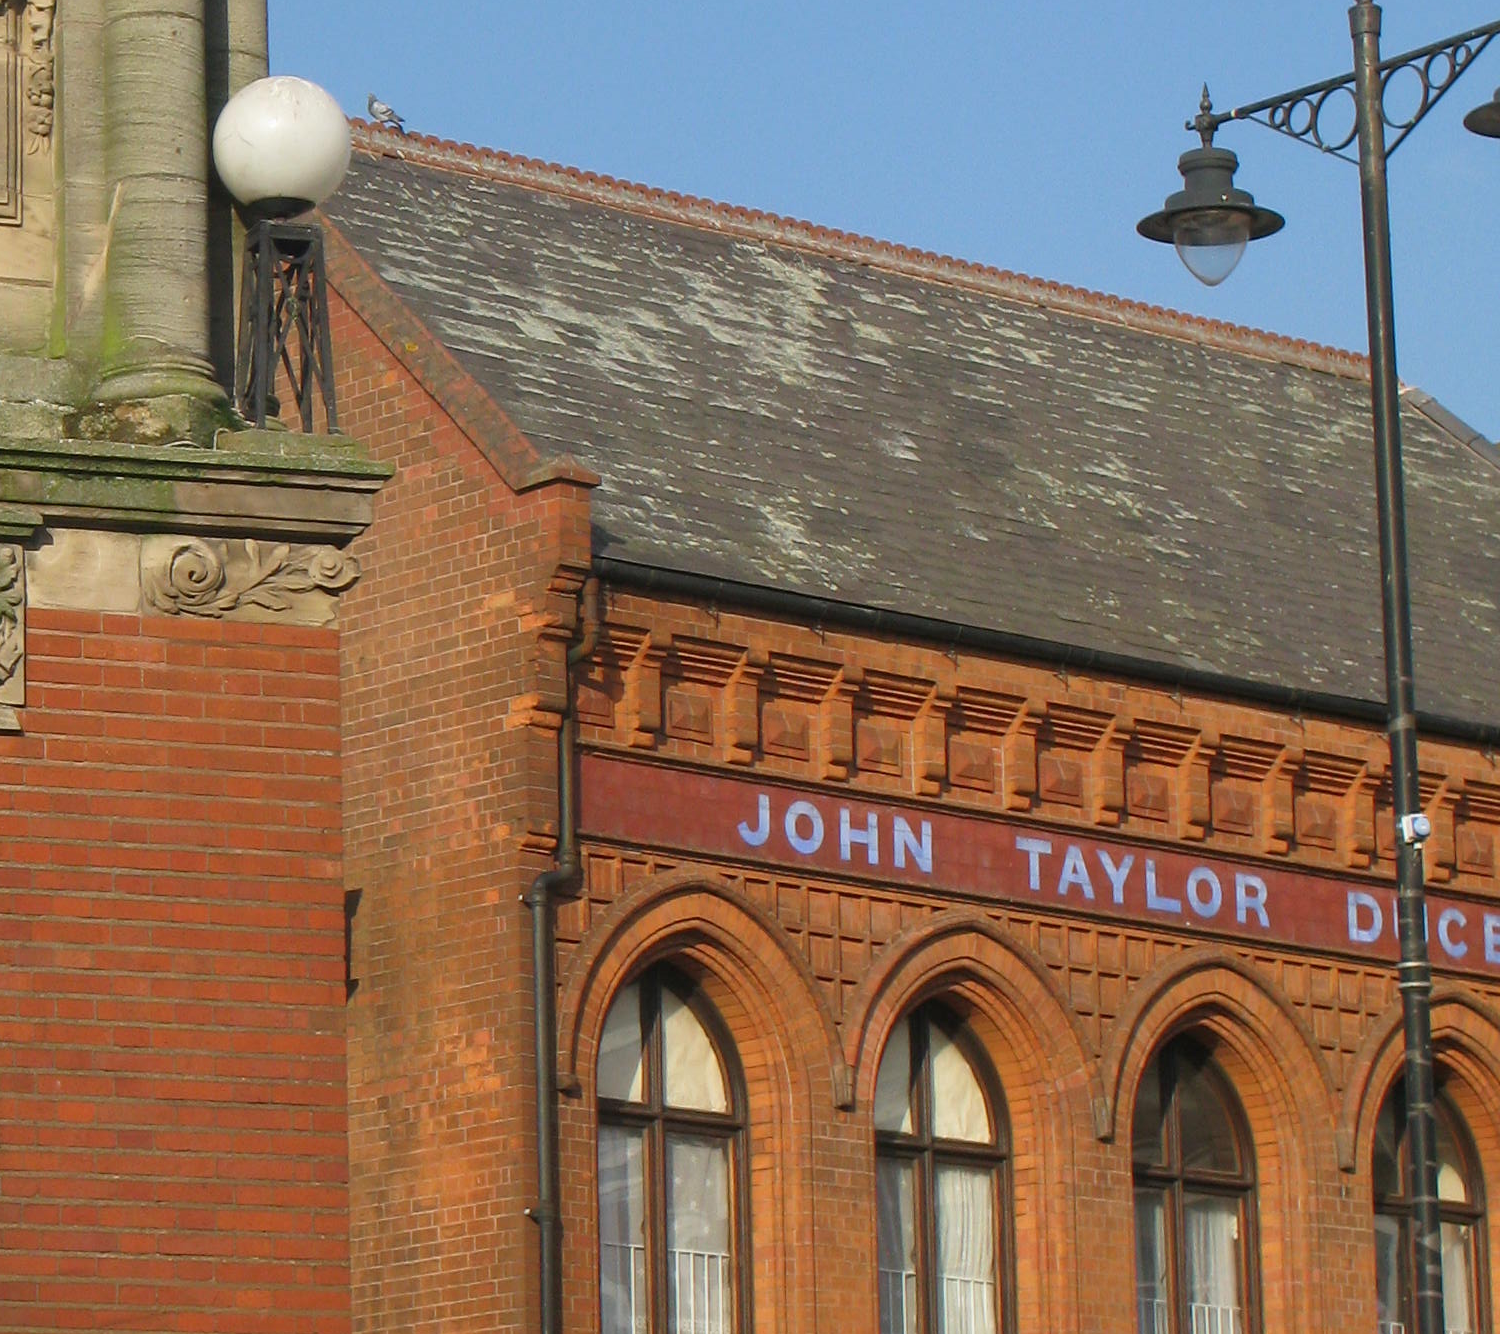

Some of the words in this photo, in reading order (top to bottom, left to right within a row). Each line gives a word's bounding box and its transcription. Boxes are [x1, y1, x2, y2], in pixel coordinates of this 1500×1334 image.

[737, 793, 933, 874] JOHN
[1015, 836, 1271, 929] TAYLOR
[1347, 890, 1500, 965] DCE
